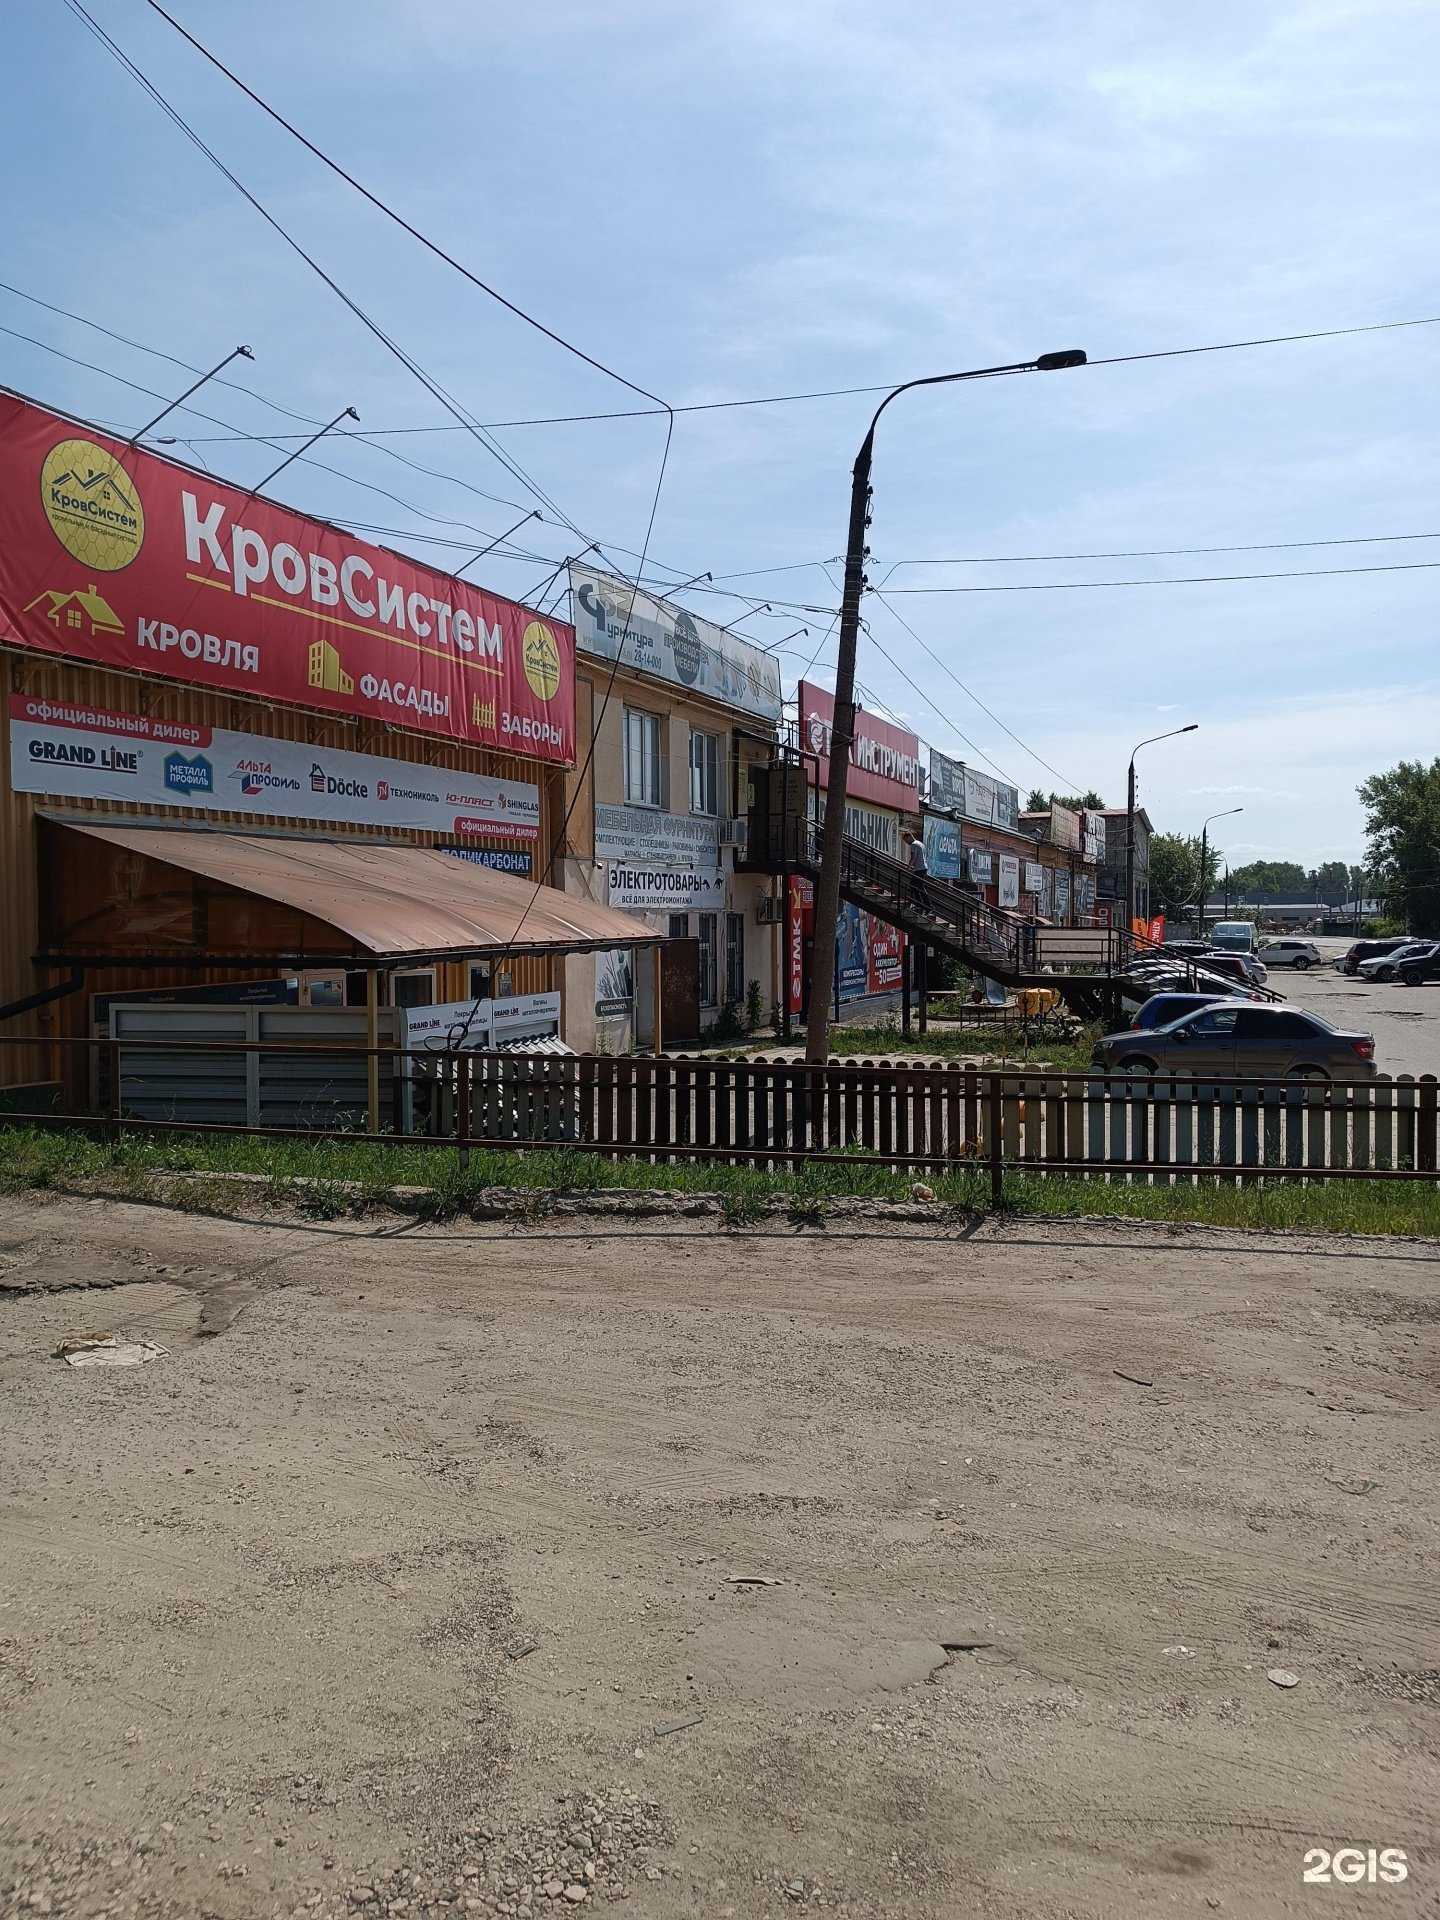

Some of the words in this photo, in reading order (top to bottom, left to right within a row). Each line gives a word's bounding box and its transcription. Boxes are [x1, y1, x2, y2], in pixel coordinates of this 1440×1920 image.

[51, 488, 137, 529] КровСистем
[181, 491, 504, 664] КровСистем
[136, 616, 260, 673] КРОВЛЯ
[359, 674, 450, 718] ФАСАДЫ
[26, 701, 149, 734] официальный
[153, 723, 201, 744] дилер
[501, 711, 563, 747] ЗАБОРЫ
[28, 740, 96, 764] GRAND
[101, 745, 138, 771] LINE
[236, 759, 272, 775] АЛЬТА
[857, 735, 920, 788] ИНСТРУМЕНТ
[169, 764, 207, 778] МЕТАЛЛ
[169, 773, 209, 786] ПРОФИЛЬ
[251, 773, 301, 791] ПРОФИЛЬ
[327, 776, 368, 799] Döcke
[390, 786, 440, 803] ТЕХНОНИКОЛЬ
[506, 798, 539, 813] SHINGLAS
[461, 820, 515, 836] официальный
[516, 828, 538, 840] дилер
[440, 848, 531, 871] ОЛИКАРБОНАТ
[610, 869, 702, 892] ЭЛЕКТРОТОВАРЫ
[633, 895, 645, 905] ДЛЯ
[646, 896, 693, 906] ЭЛЕКТРОМОНТАЖА
[409, 1020, 429, 1031] GRAND
